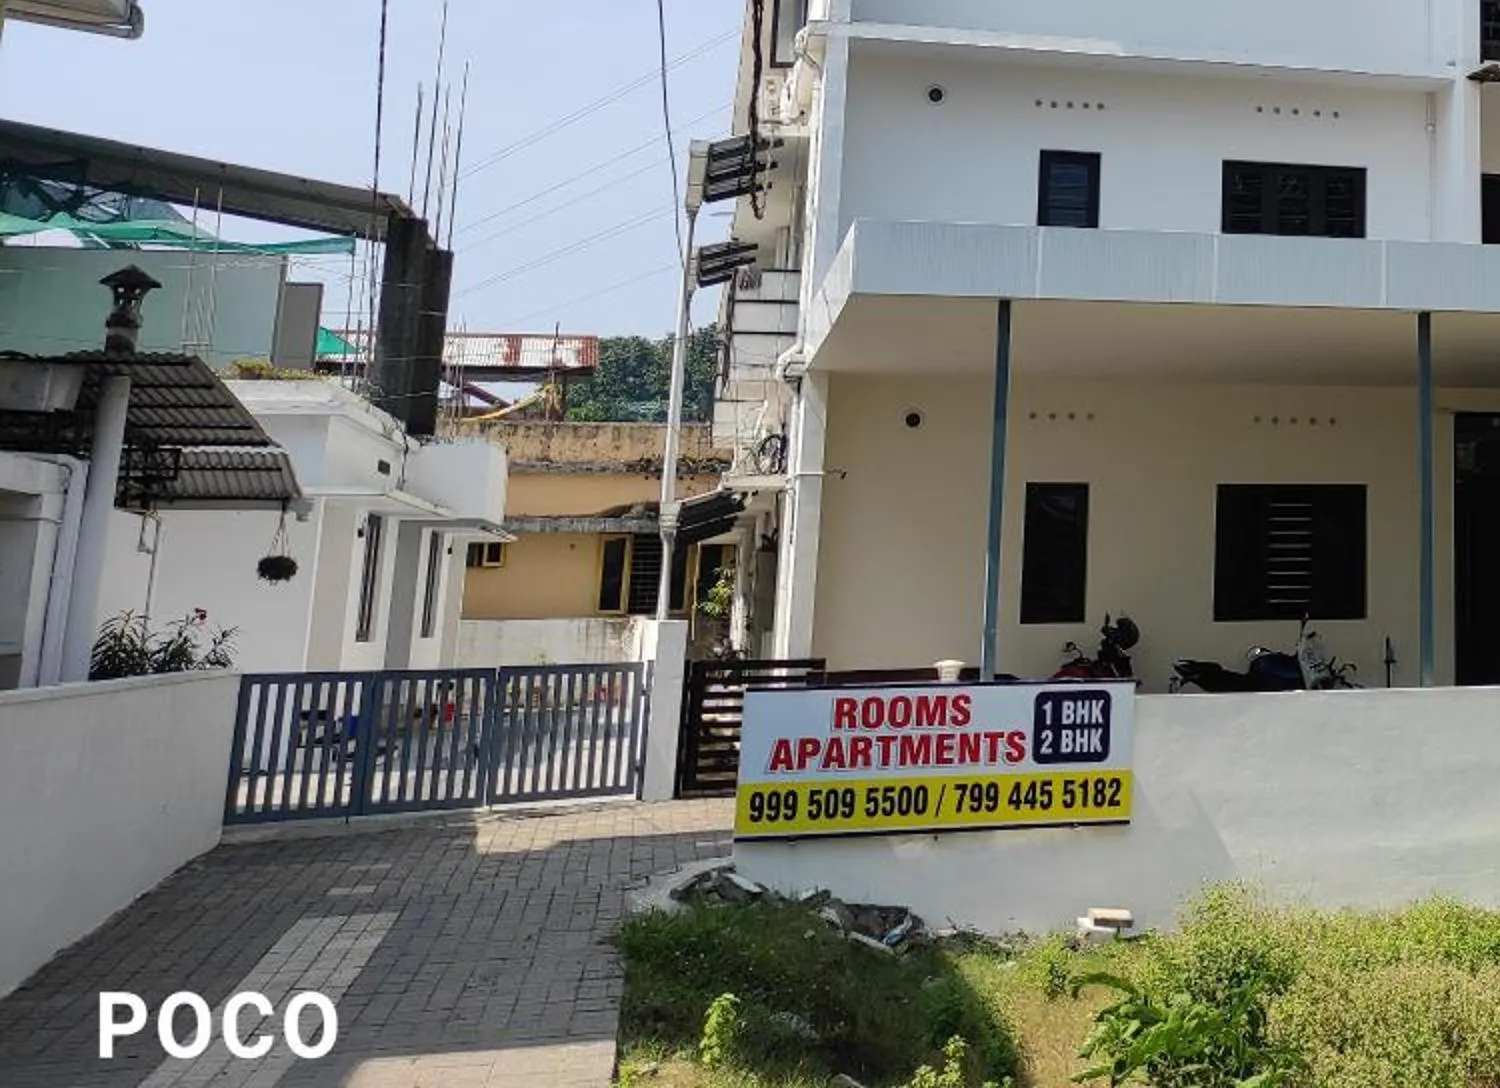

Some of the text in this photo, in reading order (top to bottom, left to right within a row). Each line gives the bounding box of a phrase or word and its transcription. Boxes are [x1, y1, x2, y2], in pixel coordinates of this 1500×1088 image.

[833, 694, 972, 730] ROOMS
[1042, 699, 1105, 725] 1 BHK
[768, 731, 1026, 771] APARTMENTS
[1040, 728, 1104, 754] 2 BHK
[749, 776, 1122, 822] 999 509 5500 / 799 445 5182
